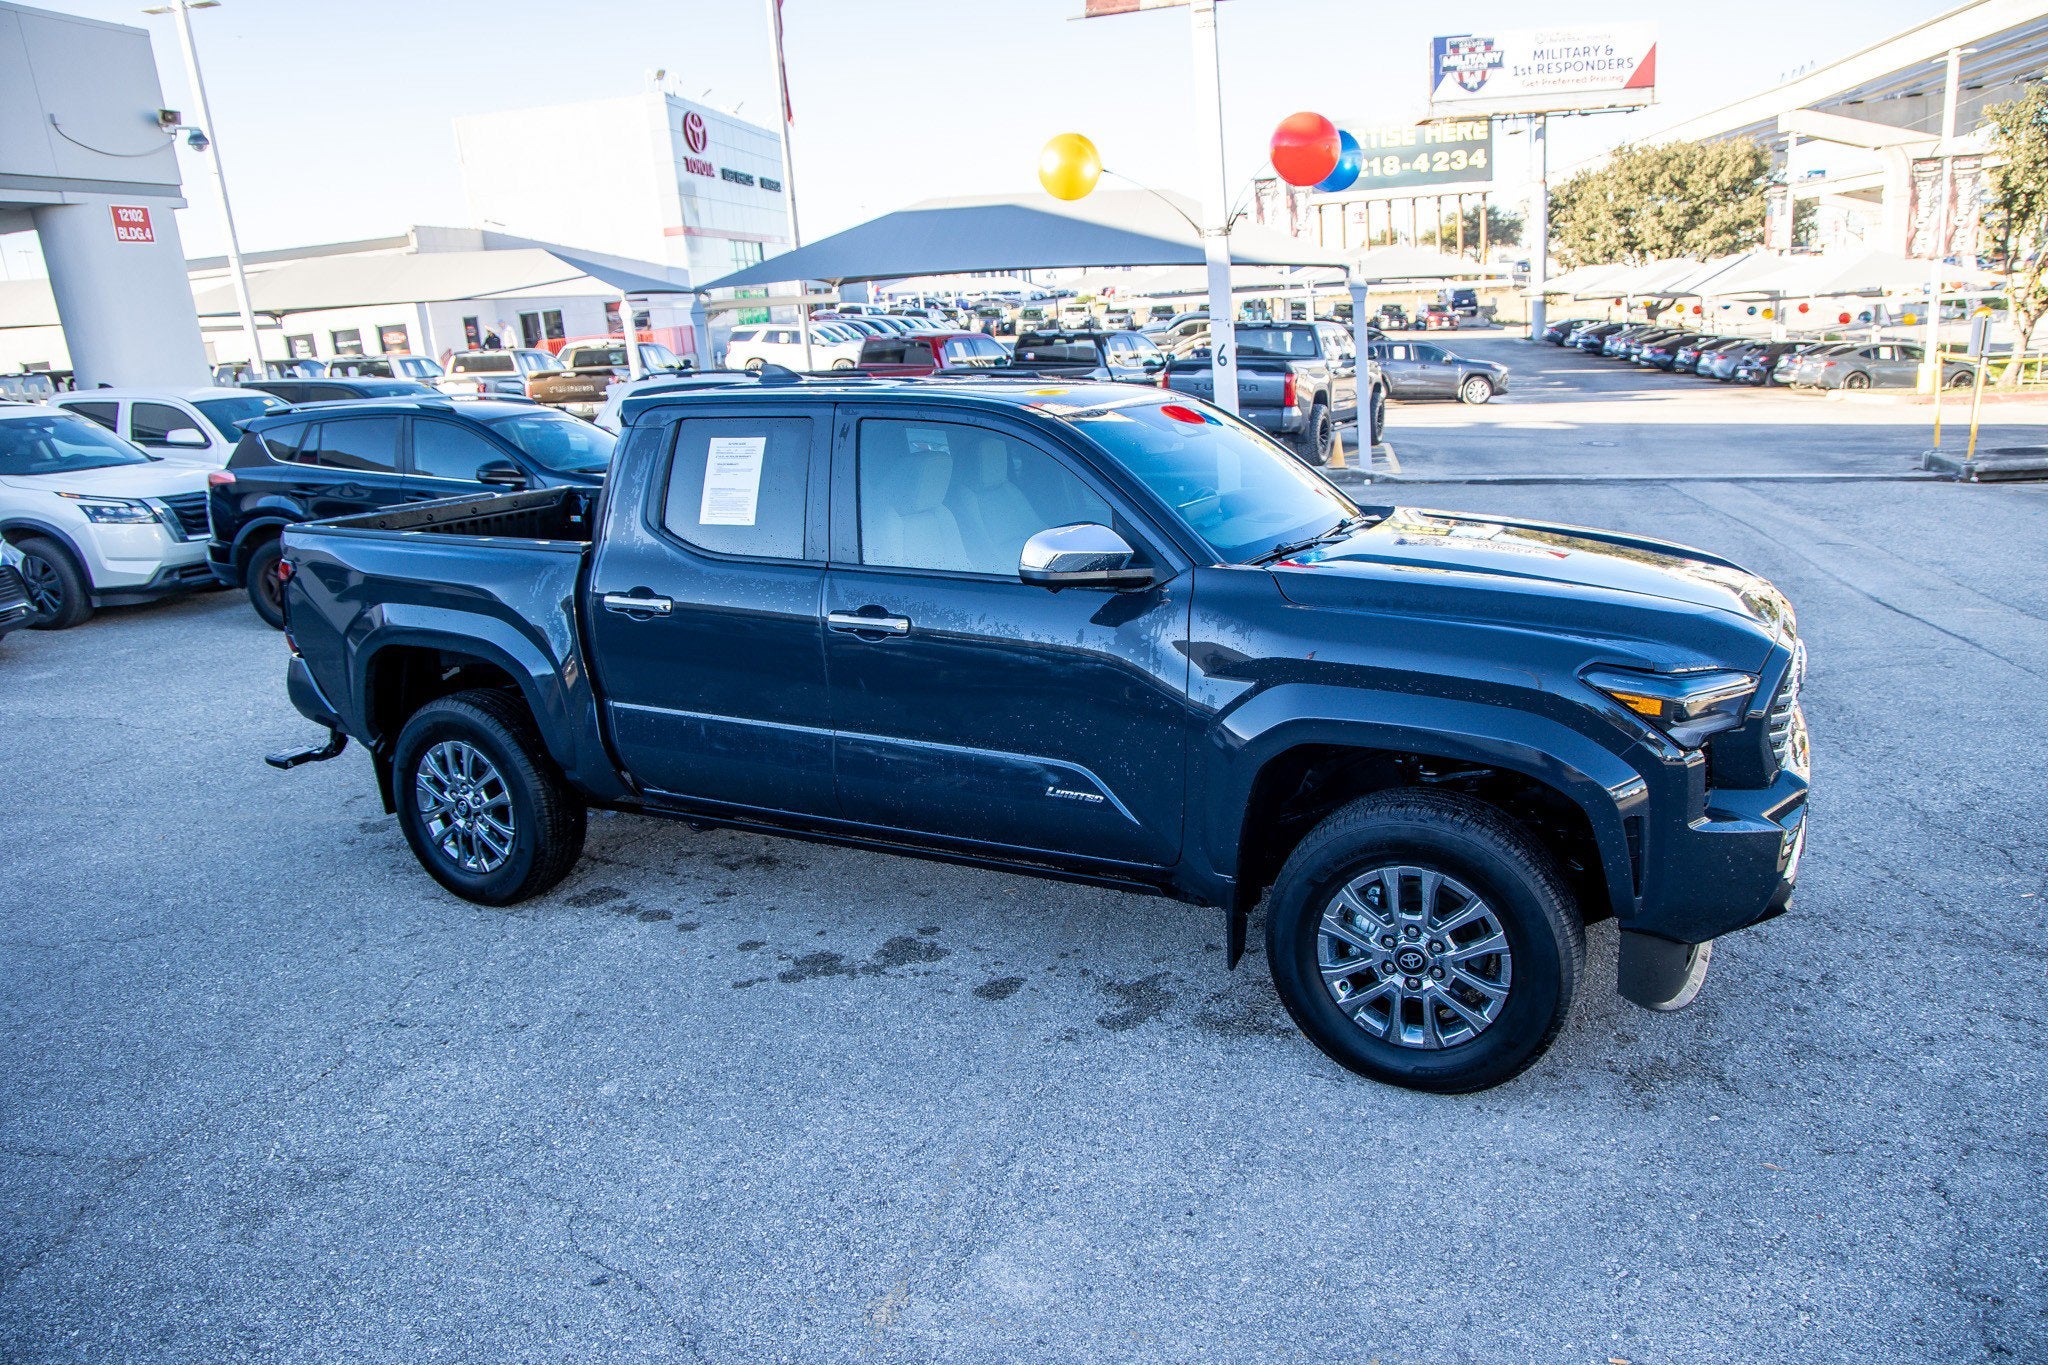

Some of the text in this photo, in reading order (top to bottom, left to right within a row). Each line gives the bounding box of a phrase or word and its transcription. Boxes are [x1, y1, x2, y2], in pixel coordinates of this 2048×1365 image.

[1442, 51, 1502, 68] MILITARY
[1534, 45, 1614, 61] MILITARY &
[1513, 57, 1634, 77] 1st RESPONDERS
[1542, 76, 1588, 86] Preferred
[1590, 74, 1624, 84] Pricing
[1351, 120, 1488, 150] RTISE HERE
[682, 156, 715, 178] TOYOTA
[117, 208, 144, 222] 12102
[1217, 343, 1228, 367] 6
[1193, 382, 1259, 392] TURA
[1044, 786, 1104, 803] LIMITED
